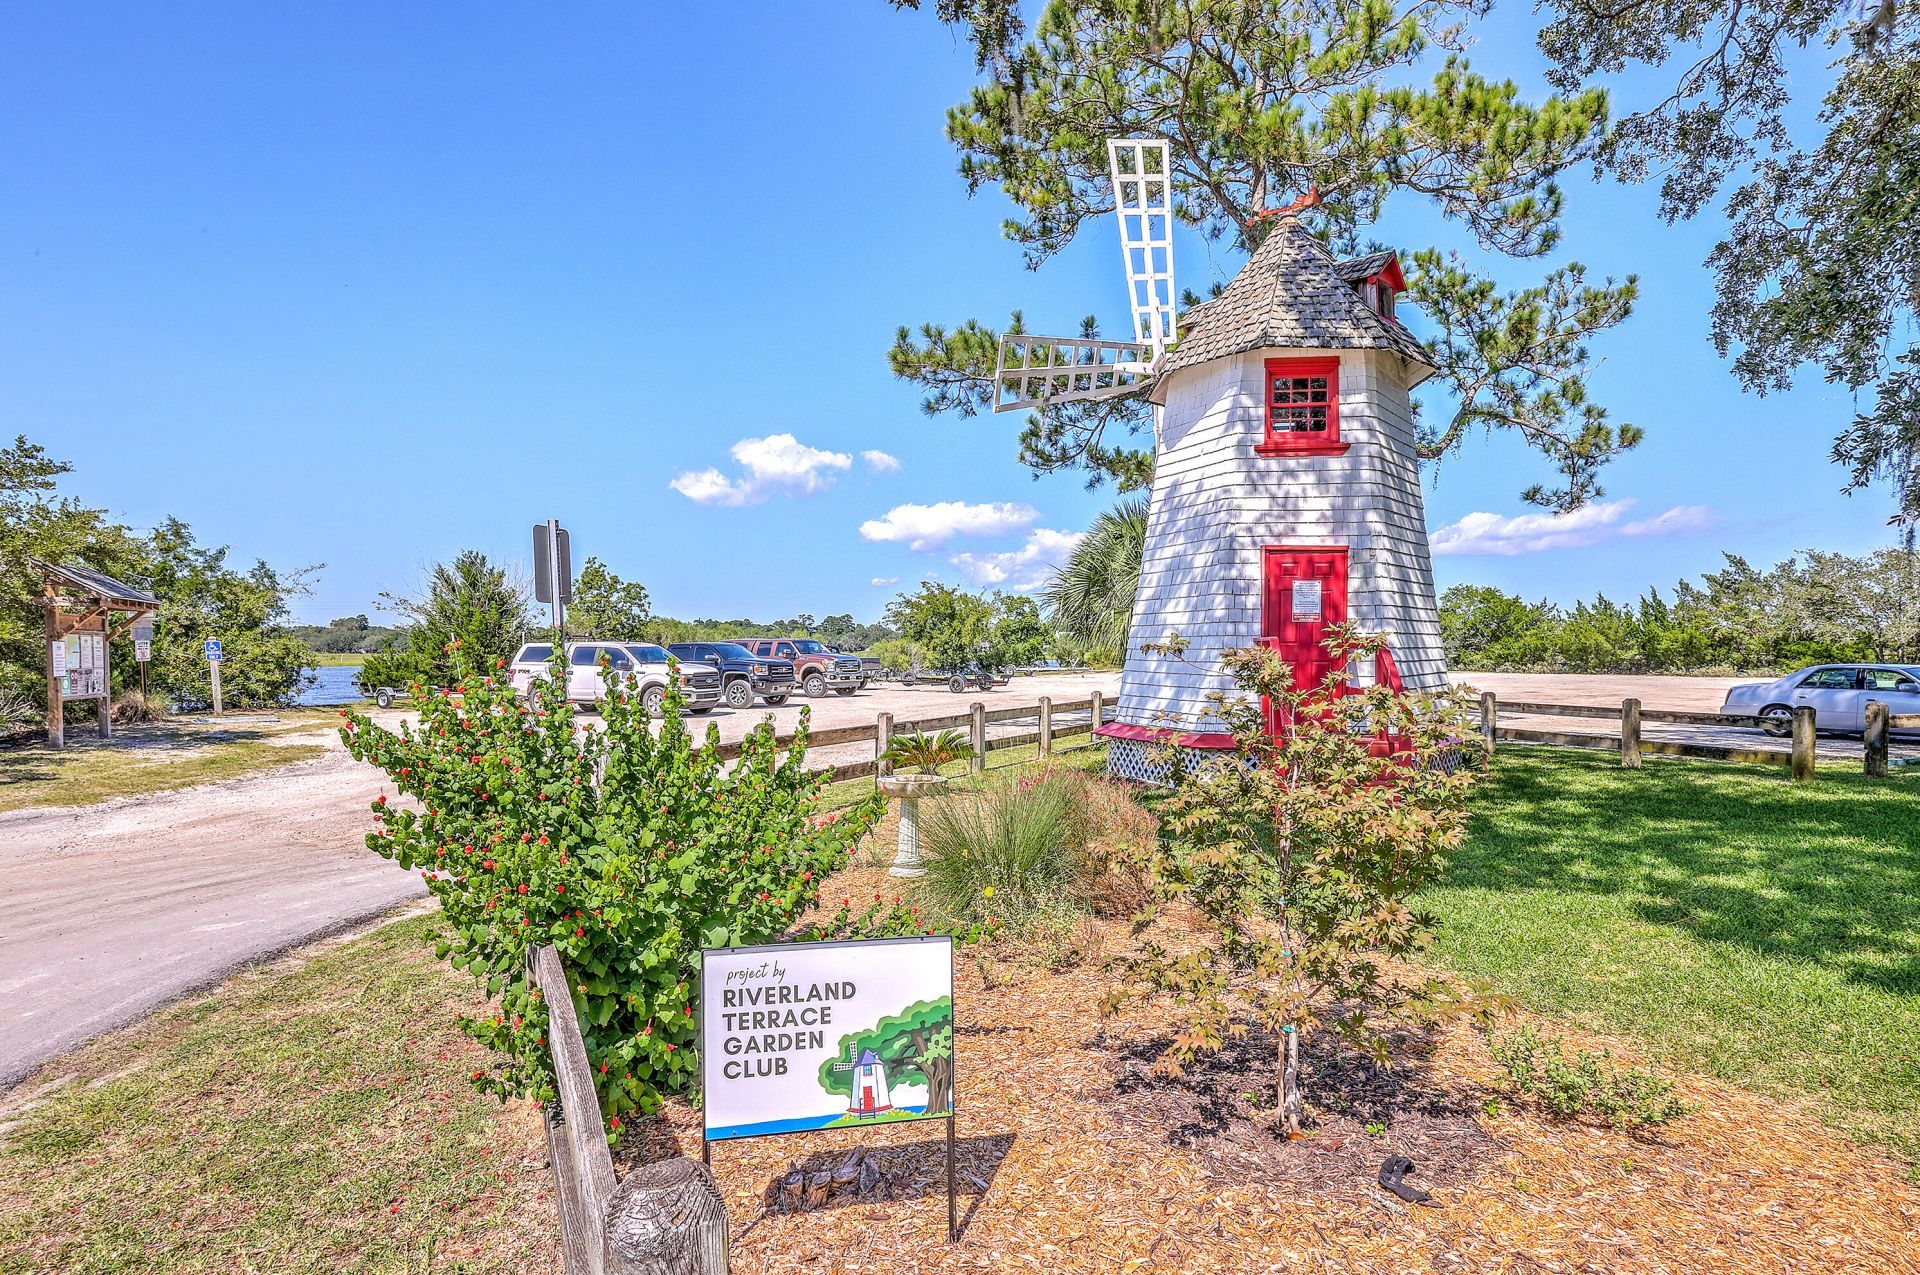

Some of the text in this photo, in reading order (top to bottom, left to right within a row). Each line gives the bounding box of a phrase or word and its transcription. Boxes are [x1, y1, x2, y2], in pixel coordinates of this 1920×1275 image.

[726, 960, 786, 985] project by
[723, 981, 857, 1008] RIVERLAND
[722, 1006, 832, 1031] TERRACE
[723, 1030, 824, 1056] GARDEN
[723, 1057, 788, 1080] CLUB
